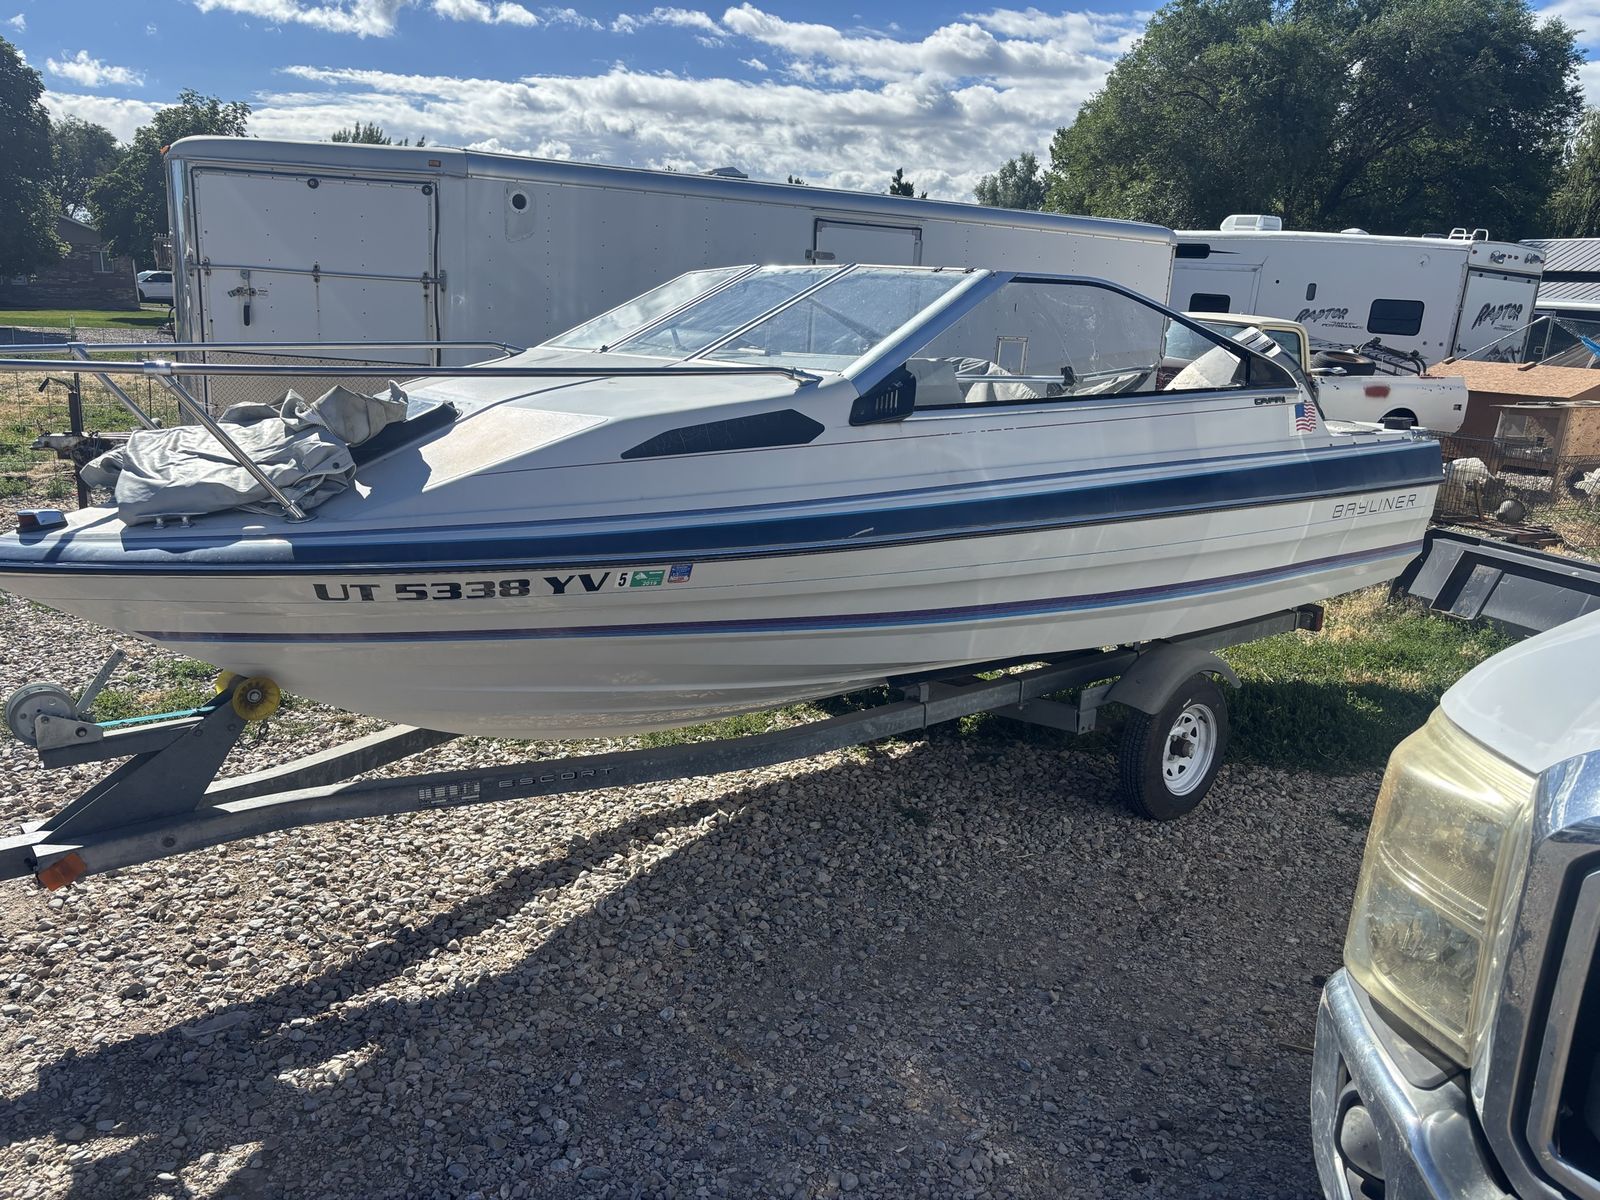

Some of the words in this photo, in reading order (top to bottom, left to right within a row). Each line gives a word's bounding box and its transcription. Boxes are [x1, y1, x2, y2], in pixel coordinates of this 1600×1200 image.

[1294, 308, 1349, 323] RAPTOR
[1471, 303, 1523, 329] RAPTOR
[1332, 493, 1417, 519] BAYLINER
[312, 583, 381, 601] UT
[395, 578, 531, 601] 5338
[543, 571, 611, 595] YV
[618, 572, 628, 587] 5
[498, 767, 614, 788] ESCORT
